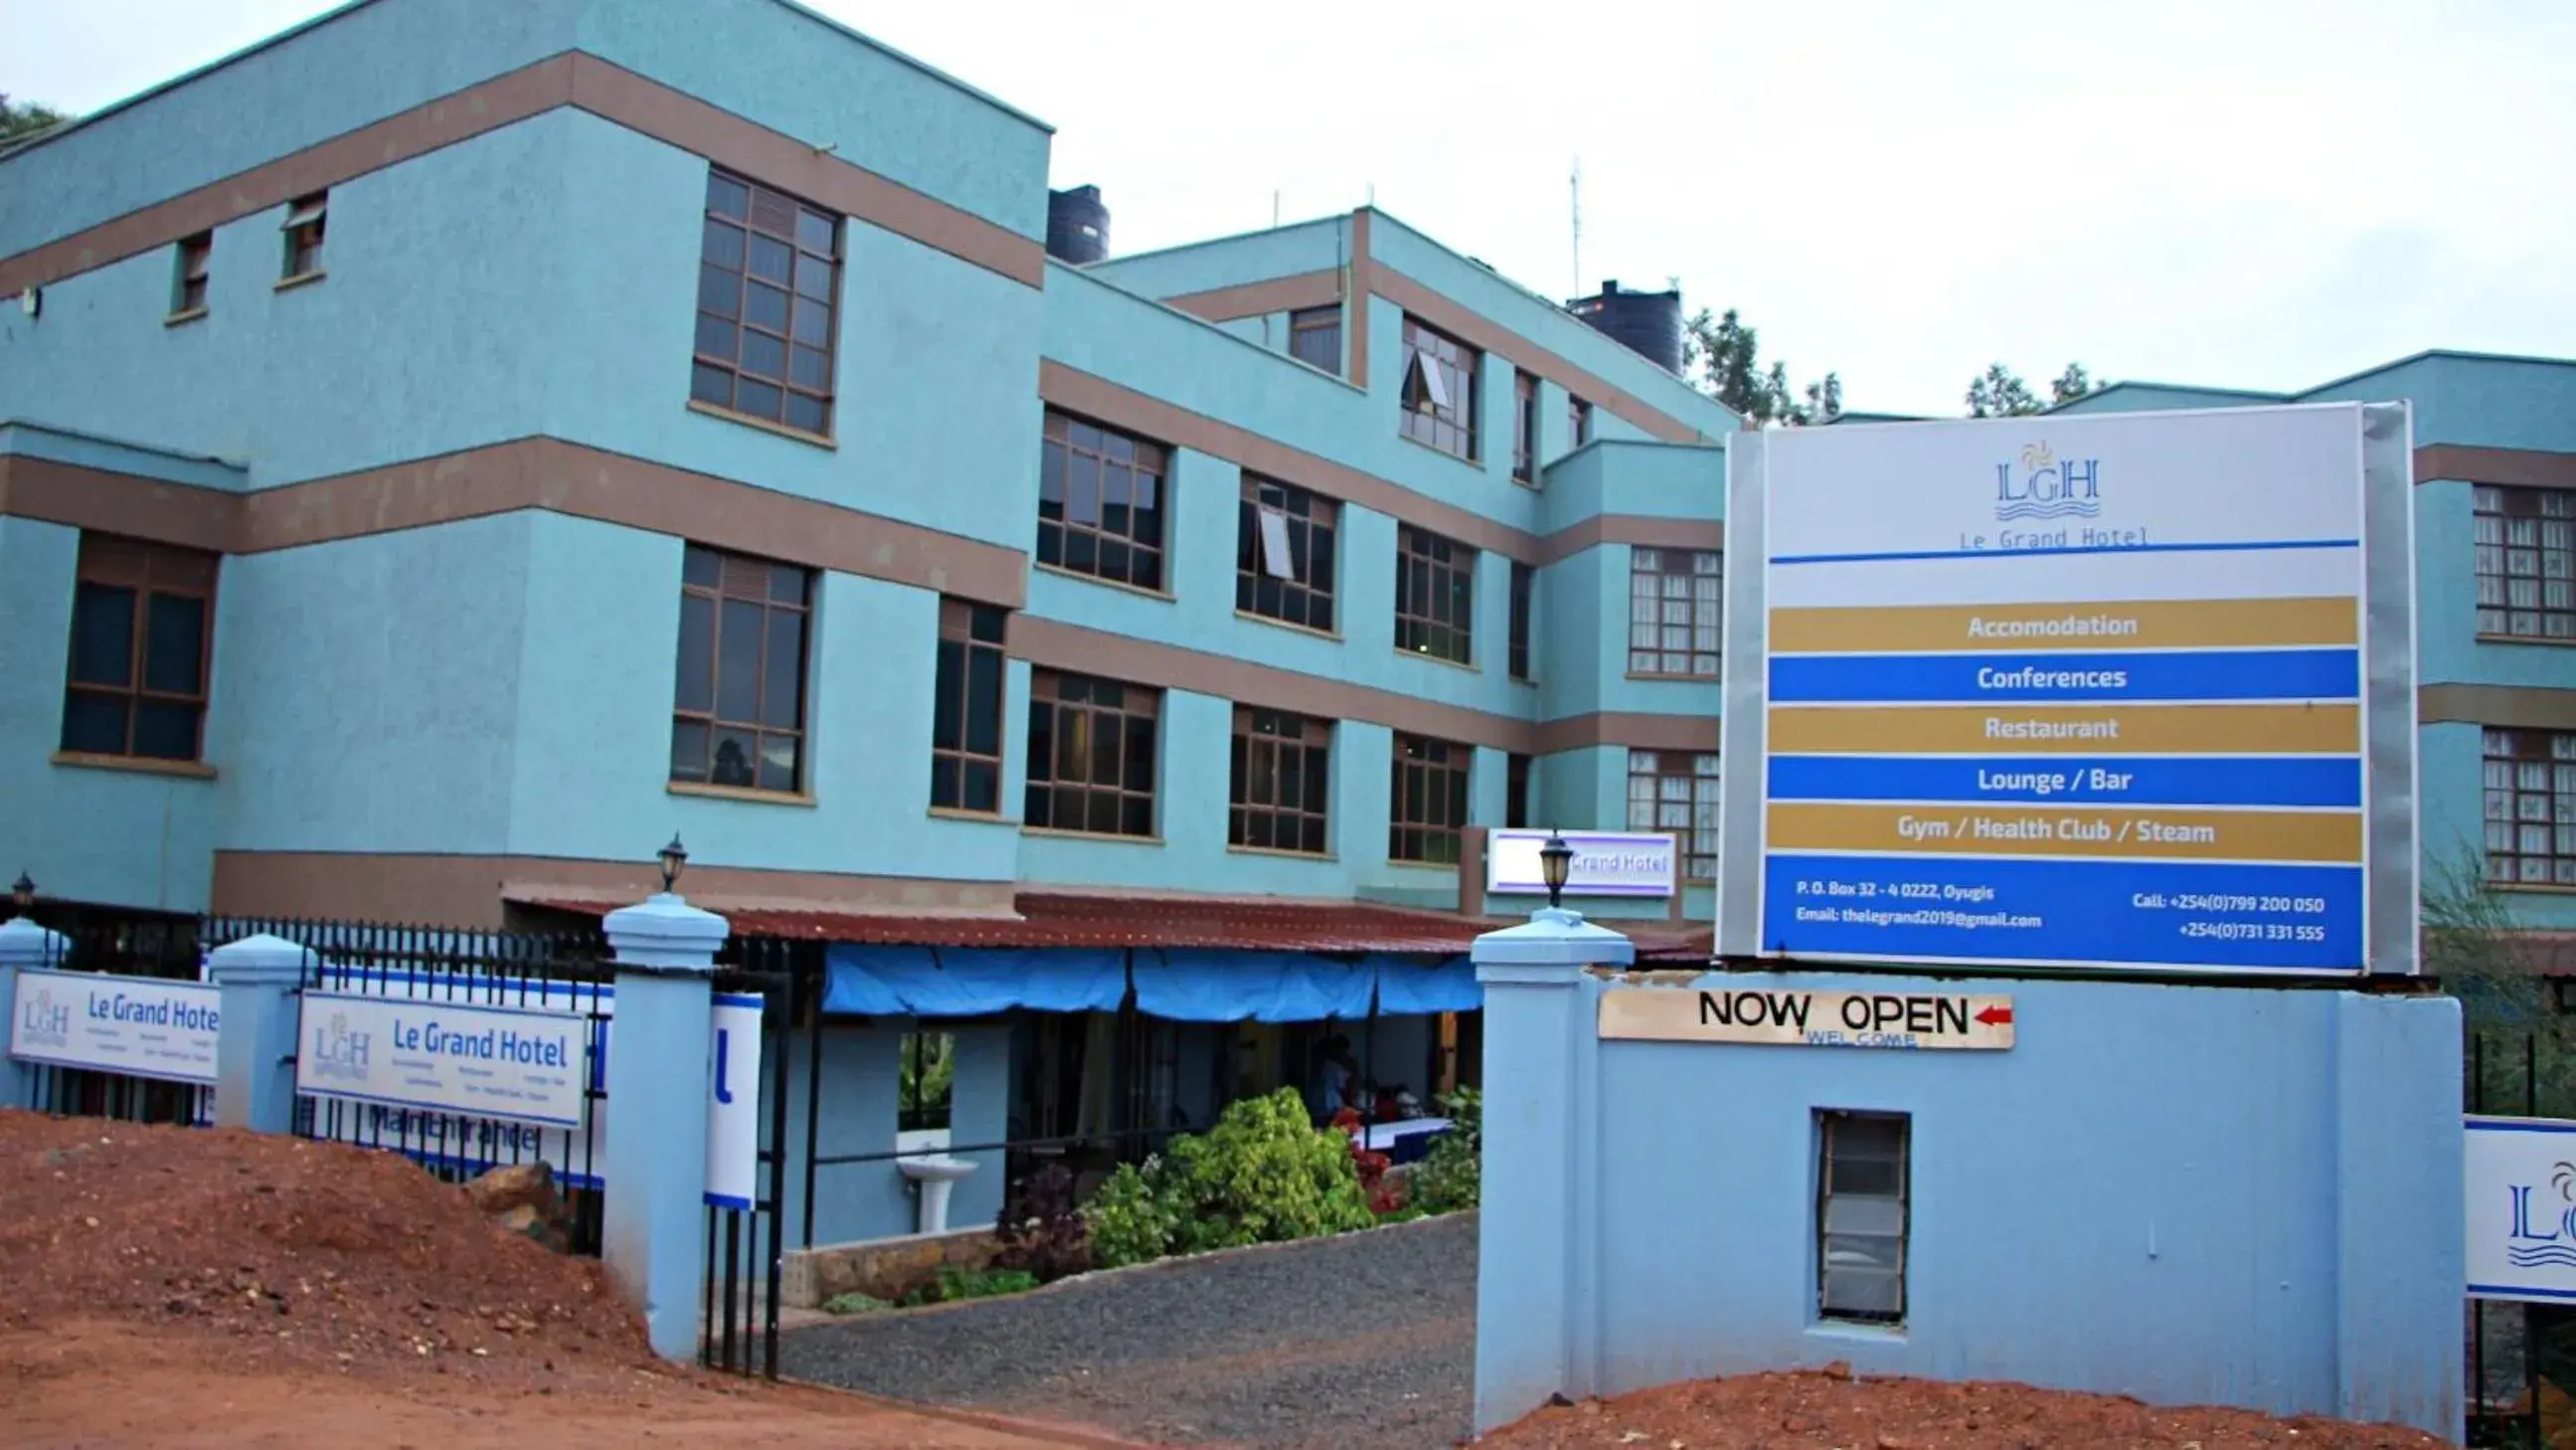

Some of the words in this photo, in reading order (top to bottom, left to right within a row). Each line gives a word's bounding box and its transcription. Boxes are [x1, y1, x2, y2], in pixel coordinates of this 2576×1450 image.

[1996, 460, 2100, 501] LGH
[1960, 532, 1985, 549] Le
[1999, 529, 2067, 548] Grand
[2082, 527, 2147, 547] Hotel
[1968, 615, 2138, 637] Accomodation
[1976, 666, 2128, 688] Conferences
[1984, 717, 2120, 739] Restaurant
[1977, 769, 2066, 795] Lounge
[2070, 769, 2085, 792] /
[2090, 769, 2134, 790] Bar
[1897, 816, 1949, 841] Gym
[1955, 817, 1969, 839] /
[1974, 816, 2052, 839] Health
[2057, 818, 2112, 840] Club
[2117, 820, 2131, 842] /
[2136, 819, 2215, 842] Steam
[1623, 853, 1667, 873] Hotel
[1828, 881, 1856, 895] Box
[1858, 882, 1876, 896] 32
[1944, 884, 1995, 902] Oyugis
[1796, 907, 1839, 922] Email:
[2259, 896, 2291, 912] 200
[2293, 897, 2325, 913] 050
[2266, 924, 2293, 940] 331
[2296, 925, 2325, 941] 555
[23, 1000, 70, 1034] LGH
[87, 991, 108, 1019] Le
[113, 994, 169, 1025] Grand
[172, 999, 219, 1031] Hote
[1698, 992, 1810, 1029] NOW
[1841, 996, 1968, 1035] OPEN
[315, 1027, 372, 1065] LGH
[394, 1018, 420, 1050] Le
[425, 1021, 494, 1059] Grand
[499, 1030, 568, 1068] Hotel
